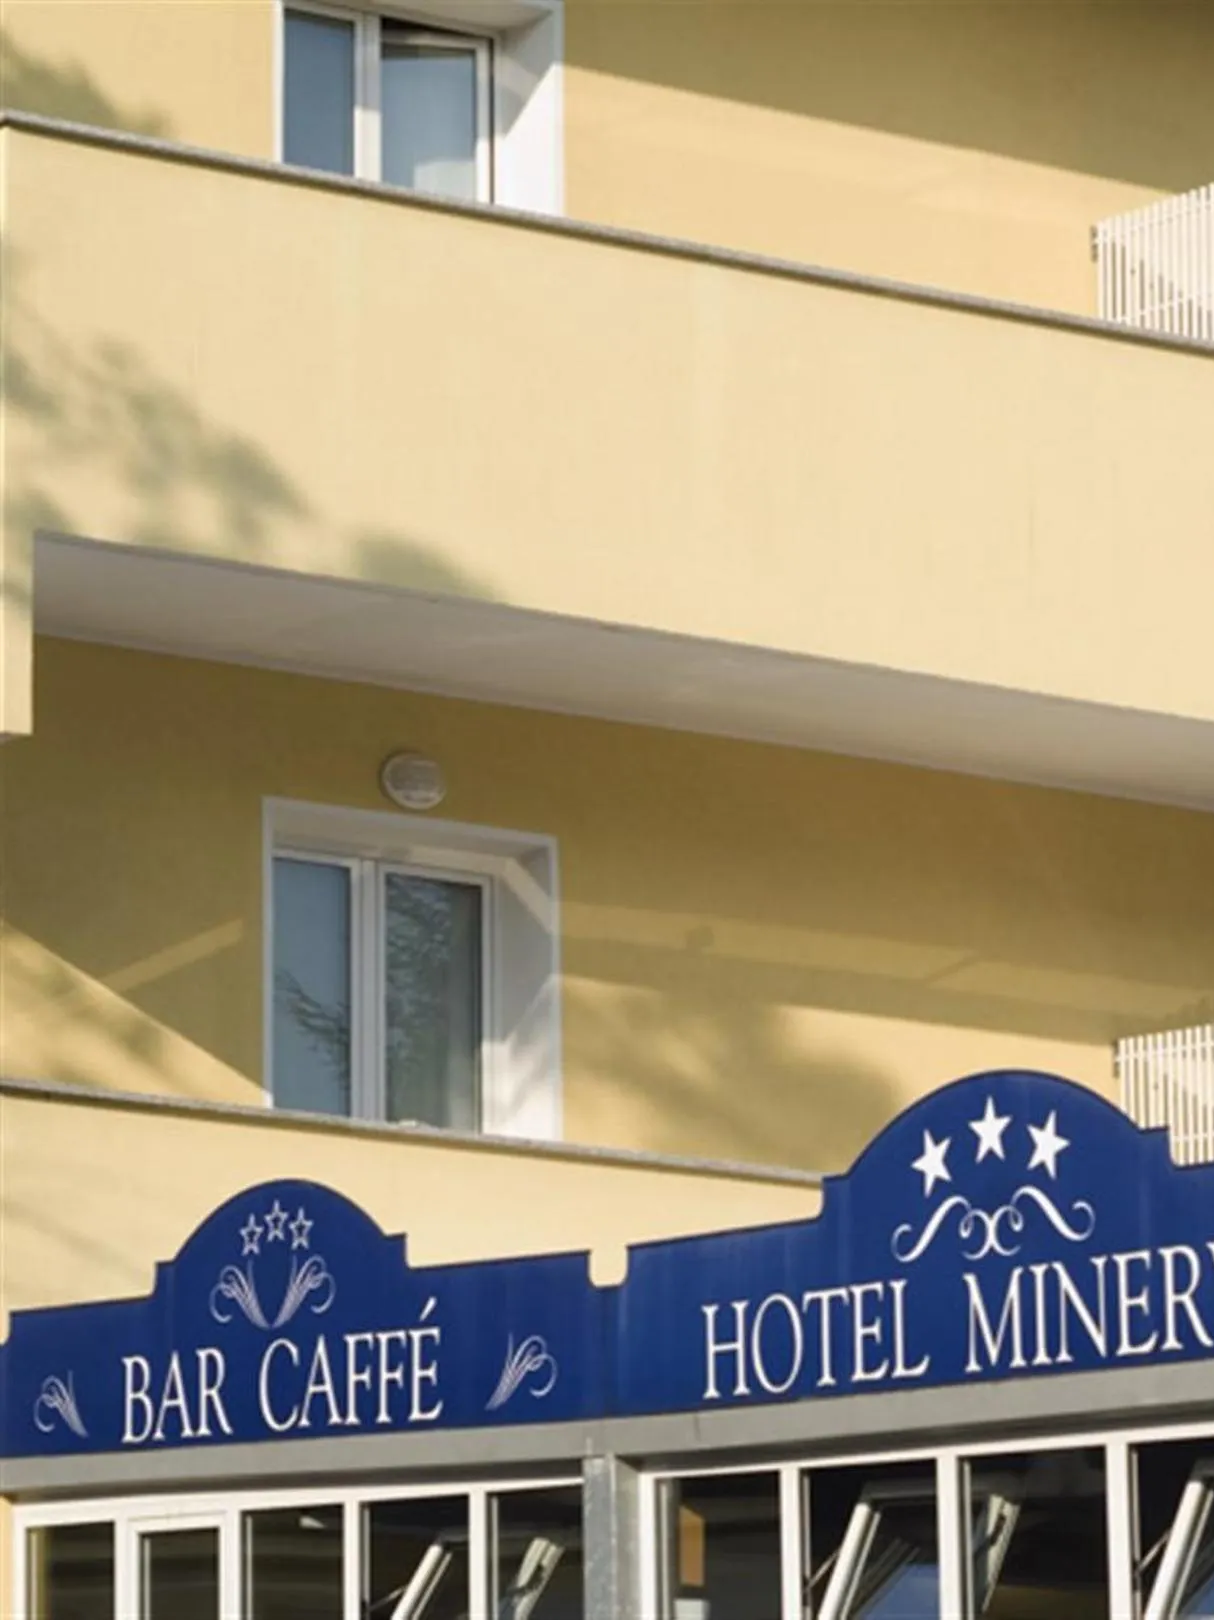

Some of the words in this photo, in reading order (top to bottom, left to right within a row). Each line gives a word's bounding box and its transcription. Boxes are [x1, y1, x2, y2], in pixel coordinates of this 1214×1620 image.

[121, 1347, 233, 1443] BAR
[259, 1297, 443, 1431] CAFFÉ
[702, 1279, 929, 1399] HOTEL
